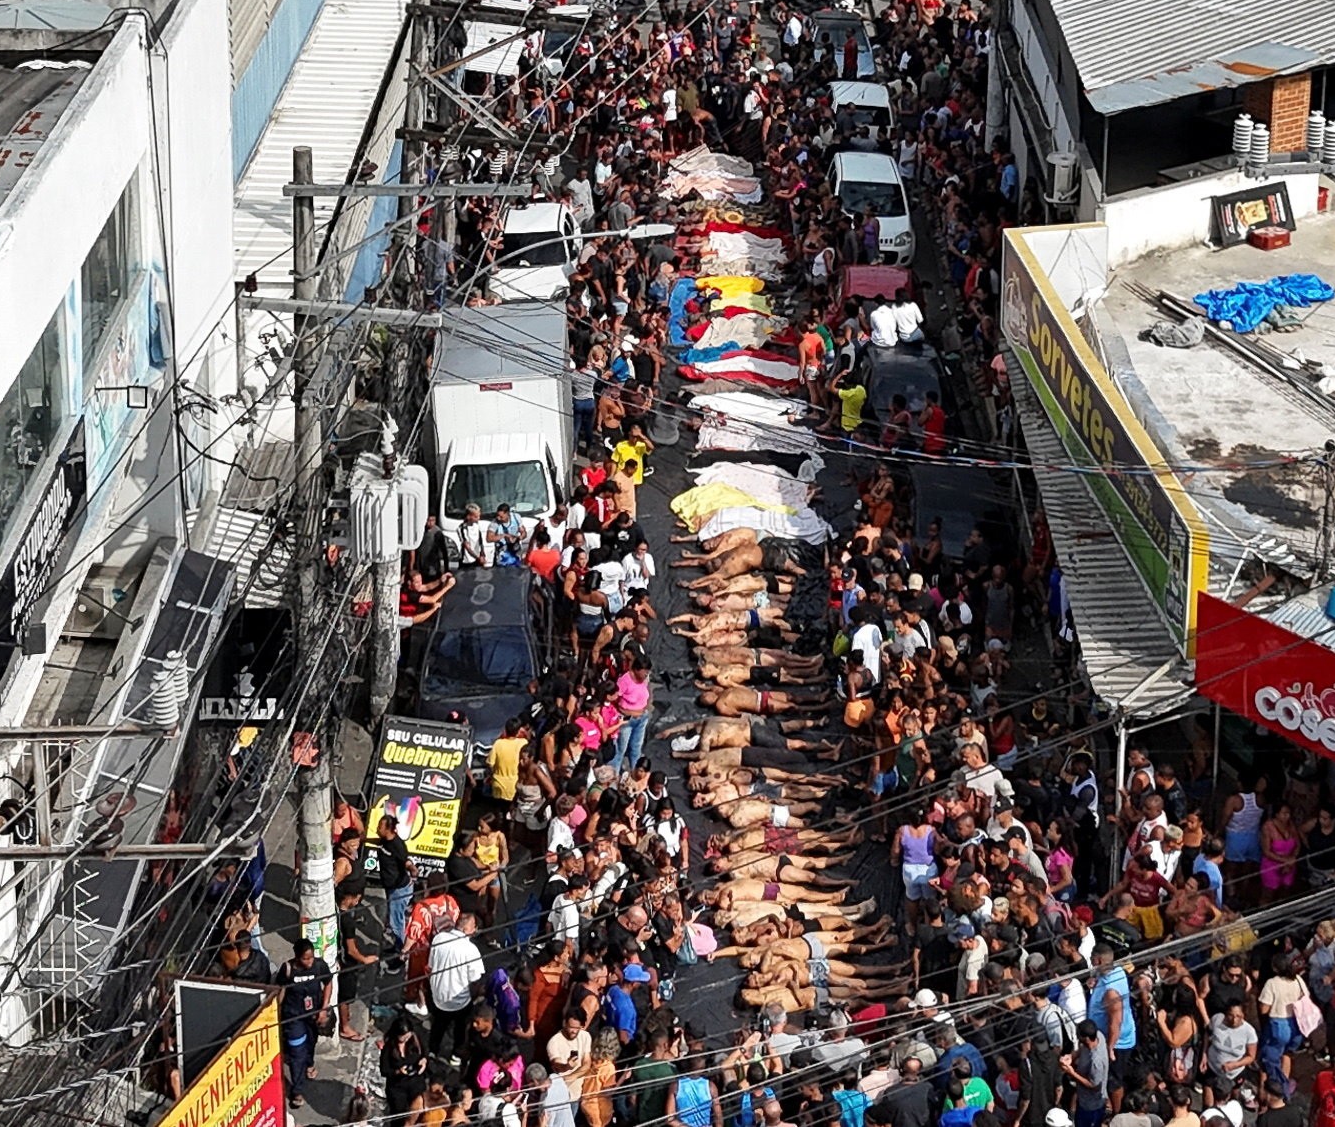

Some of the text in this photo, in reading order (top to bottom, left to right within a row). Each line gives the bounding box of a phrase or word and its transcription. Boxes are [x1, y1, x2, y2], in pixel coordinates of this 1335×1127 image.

[1029, 290, 1116, 468] Sorvetes
[383, 741, 464, 771] Quebrou?
[387, 729, 466, 751] SEU CELULAR
[174, 1024, 270, 1127] NVENIÊNCIA
